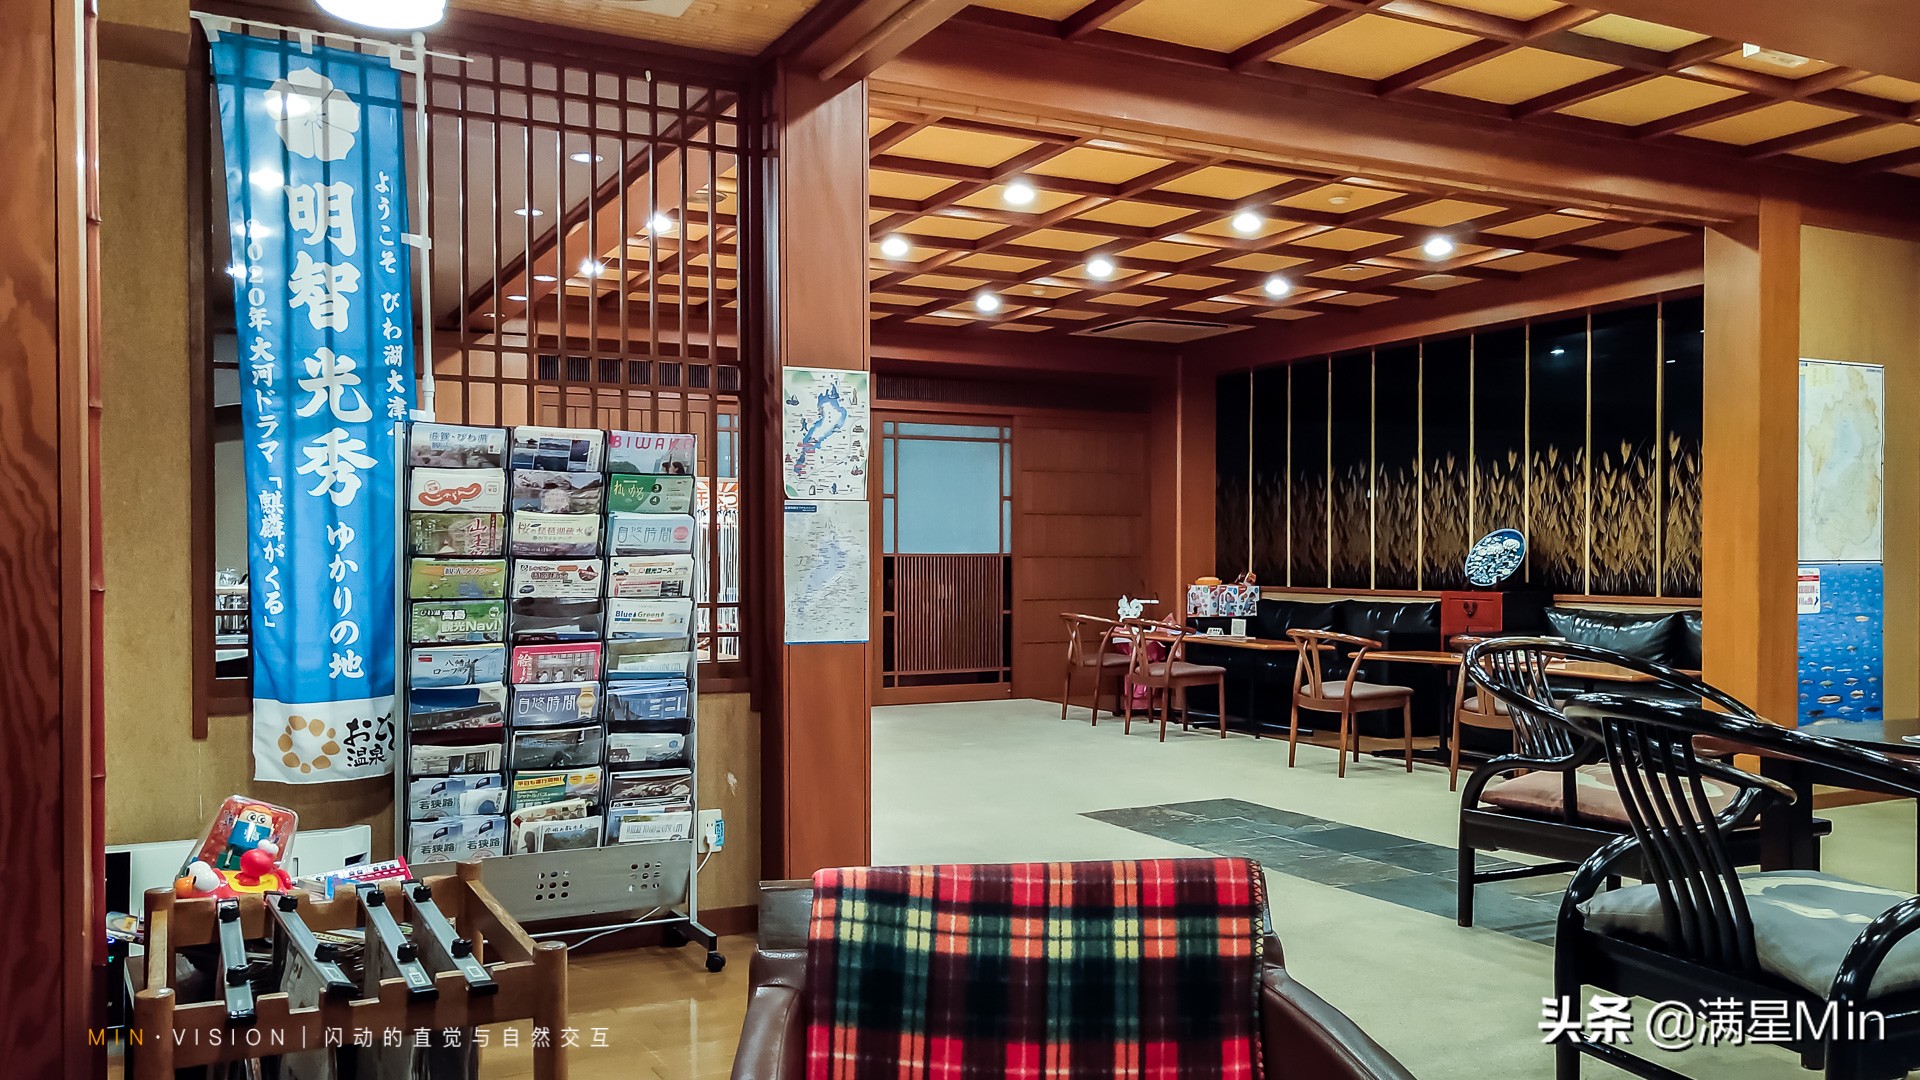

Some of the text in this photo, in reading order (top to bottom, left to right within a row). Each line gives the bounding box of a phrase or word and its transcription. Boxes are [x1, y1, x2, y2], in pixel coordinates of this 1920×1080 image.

[374, 171, 397, 274] ようこそ
[284, 181, 378, 679] 明智光秀 ゆかりの地
[441, 609, 467, 621] 高島
[615, 610, 633, 618] Blue
[441, 620, 499, 633] 観光Navi
[518, 694, 577, 716] 自悠時間
[346, 743, 388, 767] 温泉
[418, 797, 455, 811] 若狭路
[420, 842, 456, 856] 若狭路
[466, 838, 502, 851] 若狭路
